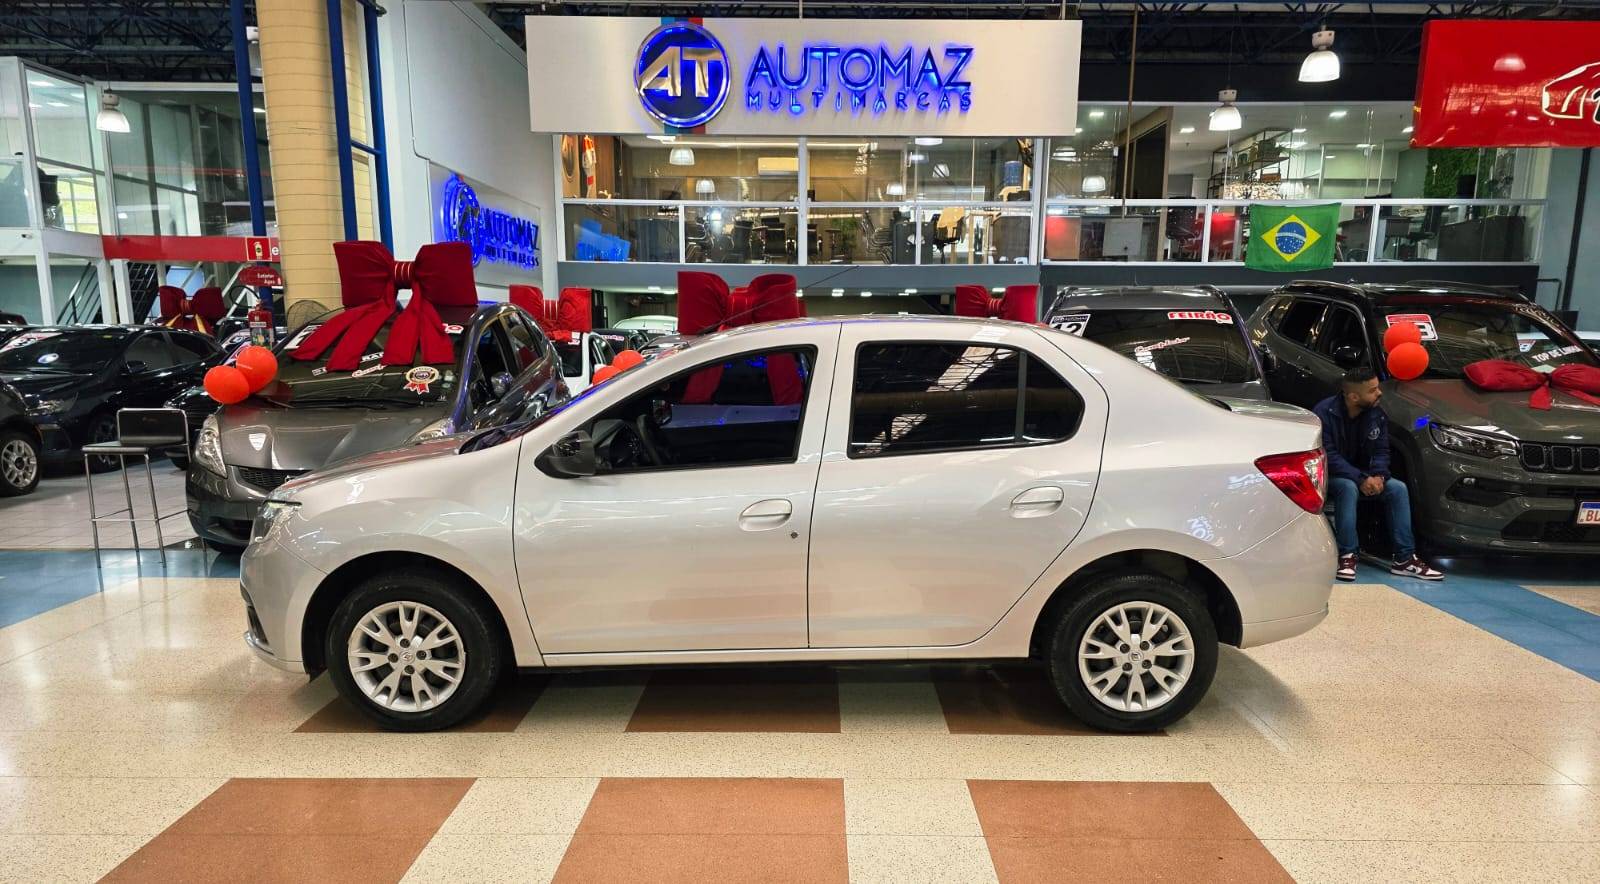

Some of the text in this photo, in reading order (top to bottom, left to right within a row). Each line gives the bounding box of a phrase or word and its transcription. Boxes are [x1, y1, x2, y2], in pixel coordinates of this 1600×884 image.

[638, 46, 723, 98] AT
[748, 46, 975, 91] AUTOMAZ
[747, 91, 973, 112] MULTIMARCAS
[480, 208, 540, 251] AUTOMAZ
[1167, 311, 1232, 323] FEIRÃO
